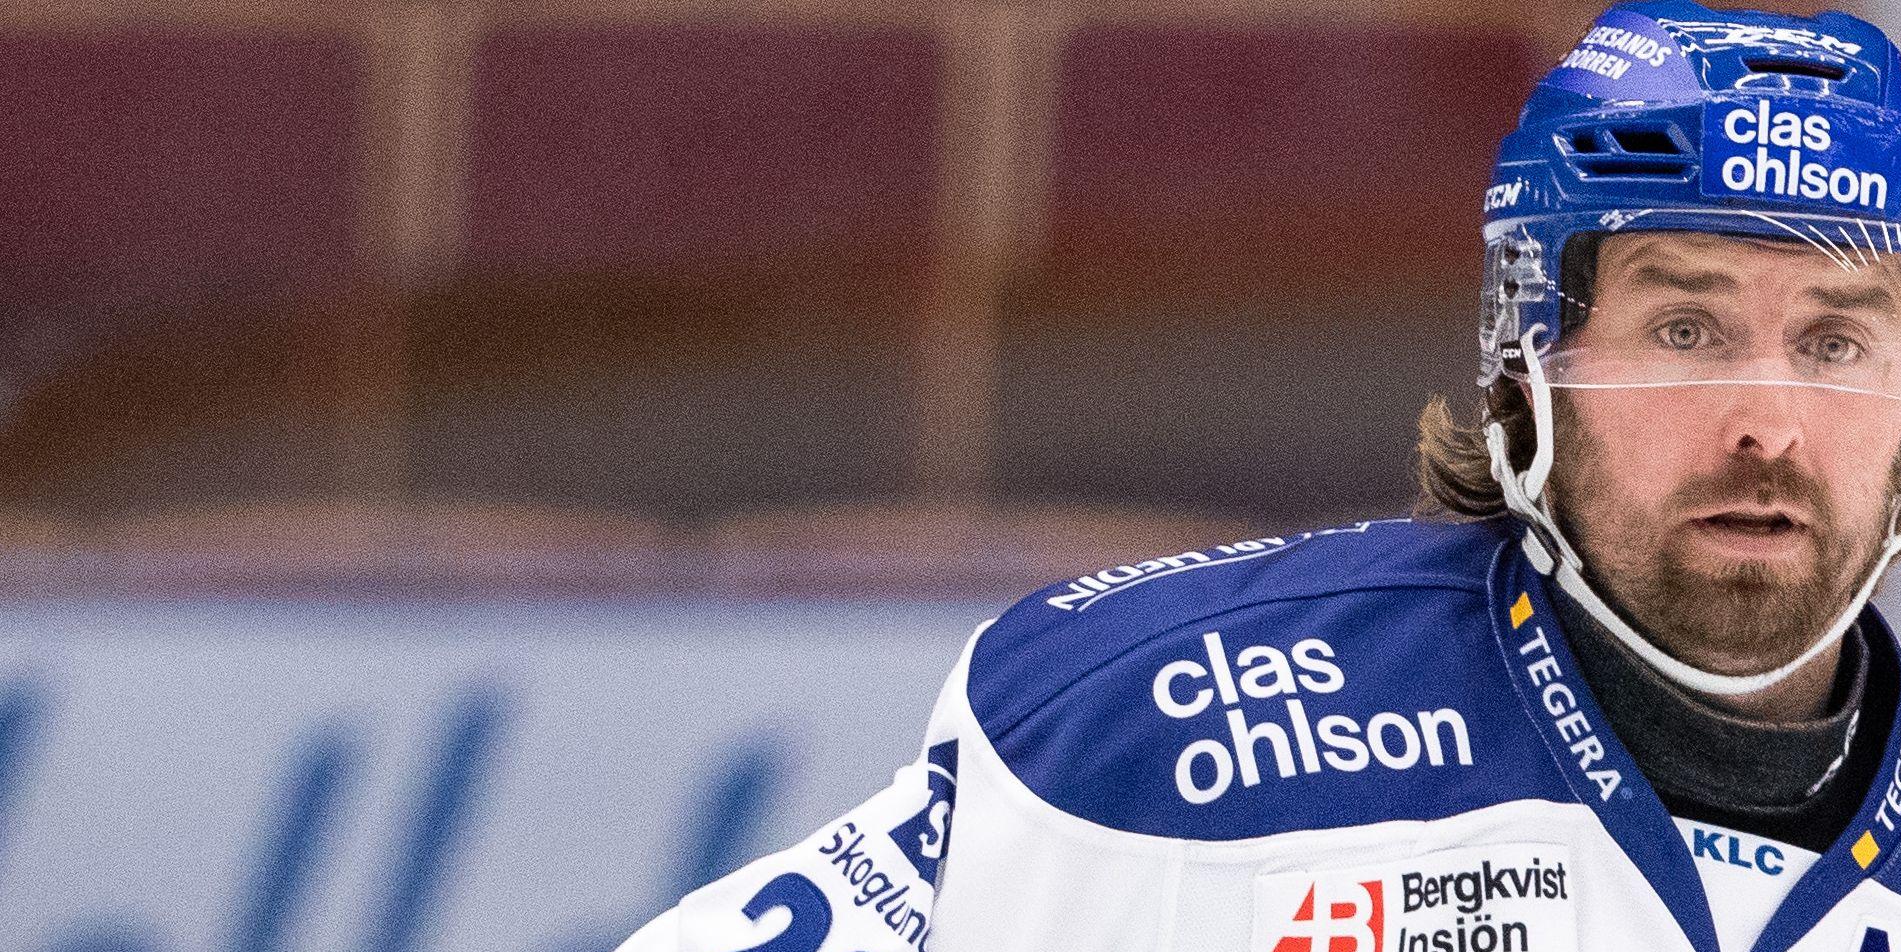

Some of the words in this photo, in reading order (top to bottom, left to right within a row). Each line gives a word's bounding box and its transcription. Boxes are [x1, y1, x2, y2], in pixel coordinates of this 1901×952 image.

[1724, 100, 1831, 151] clas
[1721, 147, 1888, 209] ohlson
[1152, 632, 1344, 720] clas
[1519, 626, 1623, 802] TEGERA
[1175, 699, 1474, 805] ohlson
[1693, 828, 1786, 876] KLC
[1401, 857, 1569, 915] Bergkvist
